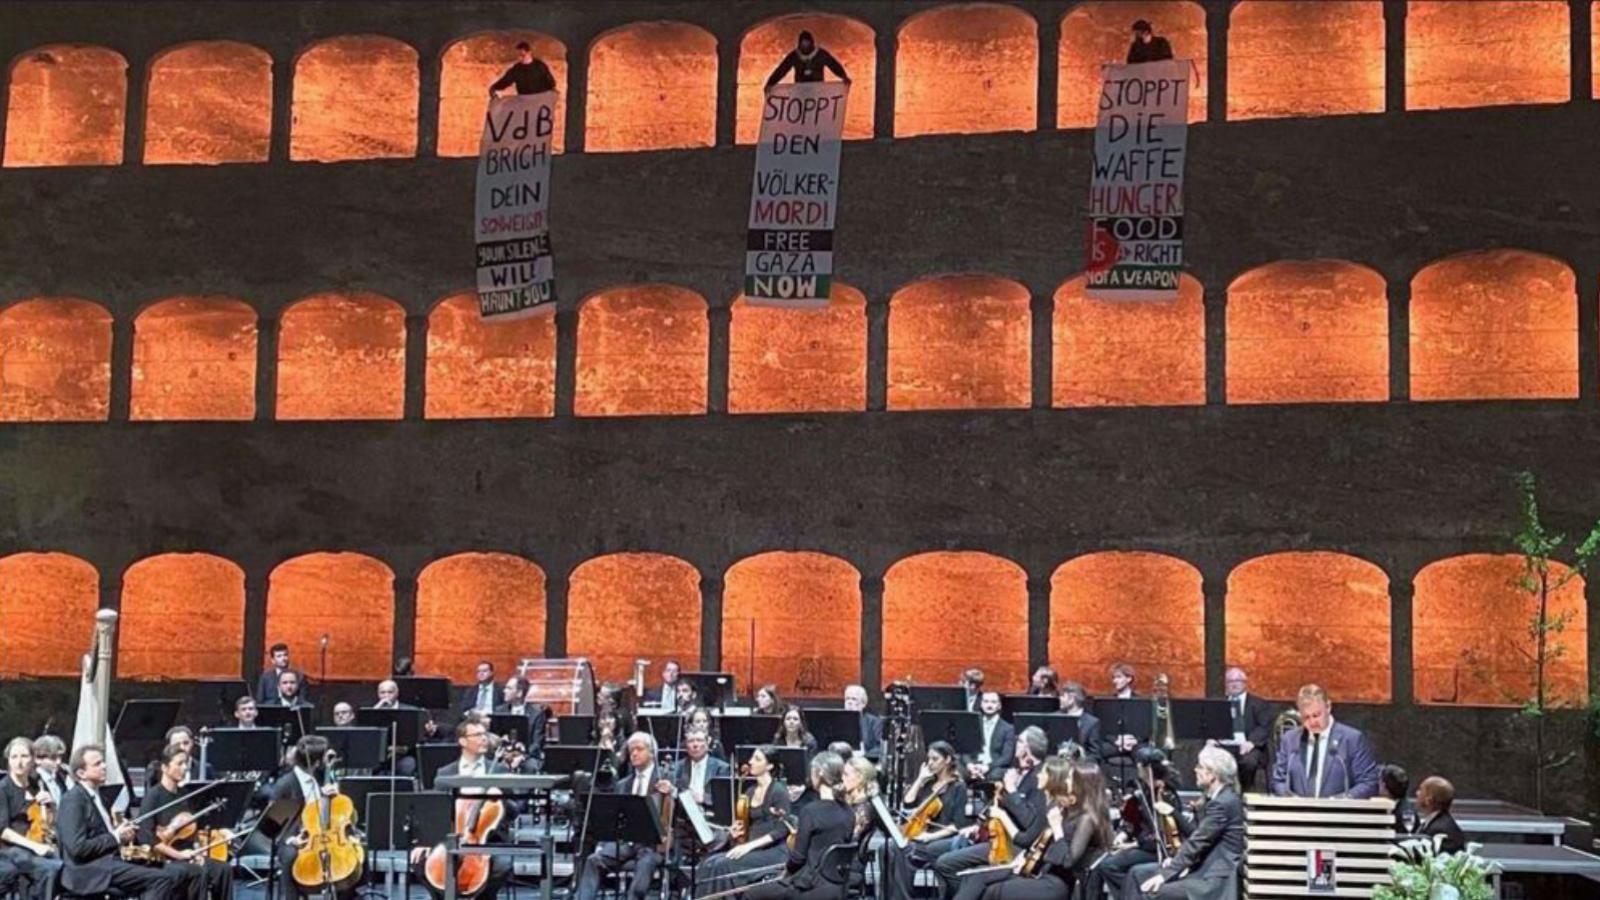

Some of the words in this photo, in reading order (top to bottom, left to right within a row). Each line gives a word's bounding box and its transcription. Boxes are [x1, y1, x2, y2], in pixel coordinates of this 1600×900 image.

[1099, 78, 1186, 110] STOPPT
[765, 95, 843, 125] STOPPT
[773, 133, 820, 155] DEN
[486, 143, 547, 175] BRICH
[1093, 148, 1181, 182] WAFFE
[757, 169, 834, 196] VÖLKER-
[491, 182, 541, 209] DEIN
[754, 201, 829, 228] MORD!
[764, 232, 811, 250] FREE
[1093, 217, 1177, 240] FOOD
[755, 253, 815, 273] GAZA
[1134, 243, 1182, 263] RIGHT
[753, 276, 817, 298] NOW
[1123, 269, 1179, 287] WEAPON
